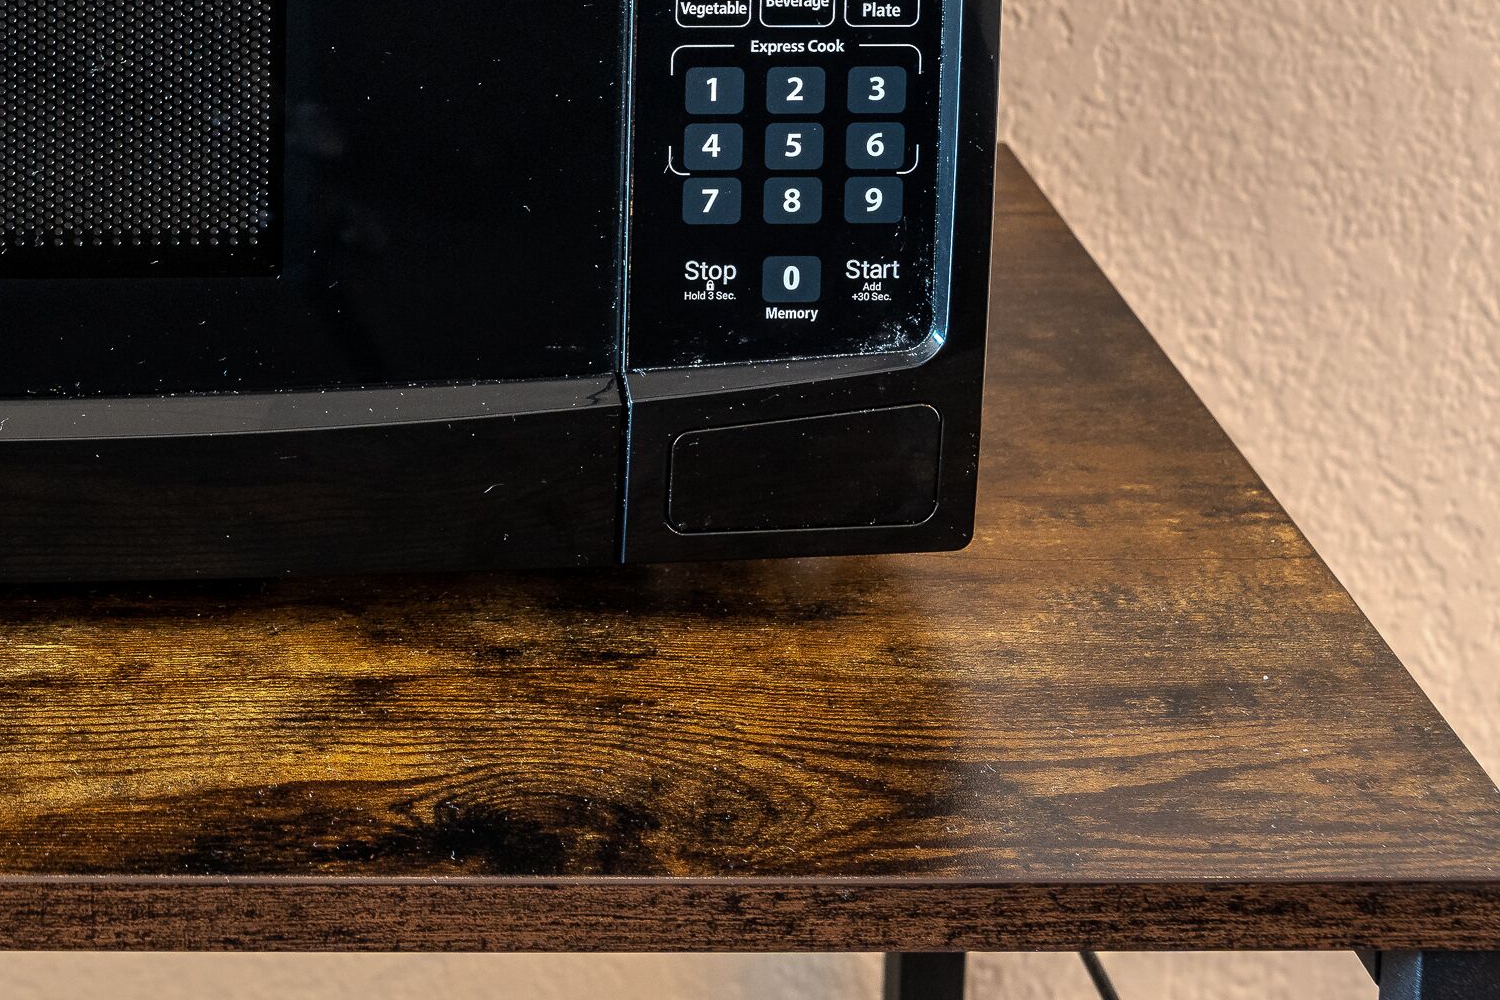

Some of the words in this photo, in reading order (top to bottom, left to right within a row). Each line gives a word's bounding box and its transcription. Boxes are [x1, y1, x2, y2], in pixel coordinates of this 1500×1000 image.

[680, 0, 748, 19] Vegetable
[862, 1, 901, 18] Plate
[750, 39, 805, 56] Express
[807, 38, 845, 53] Cook
[706, 77, 718, 102] 1
[785, 76, 804, 102] 2
[867, 75, 886, 101] 3
[701, 133, 721, 158] 4
[784, 133, 802, 158] 5
[866, 132, 885, 157] 6
[701, 188, 720, 213] 7
[782, 187, 801, 213] 8
[864, 187, 883, 213] 9
[684, 260, 737, 285] Stop
[782, 265, 801, 291] 0
[845, 259, 900, 280] Start
[684, 290, 706, 301] Hold
[707, 291, 715, 301] 3
[716, 291, 737, 301] Sec.
[851, 291, 870, 302] +30
[871, 291, 892, 301] Sec.
[862, 281, 882, 291] Add
[765, 306, 819, 322] Memory
